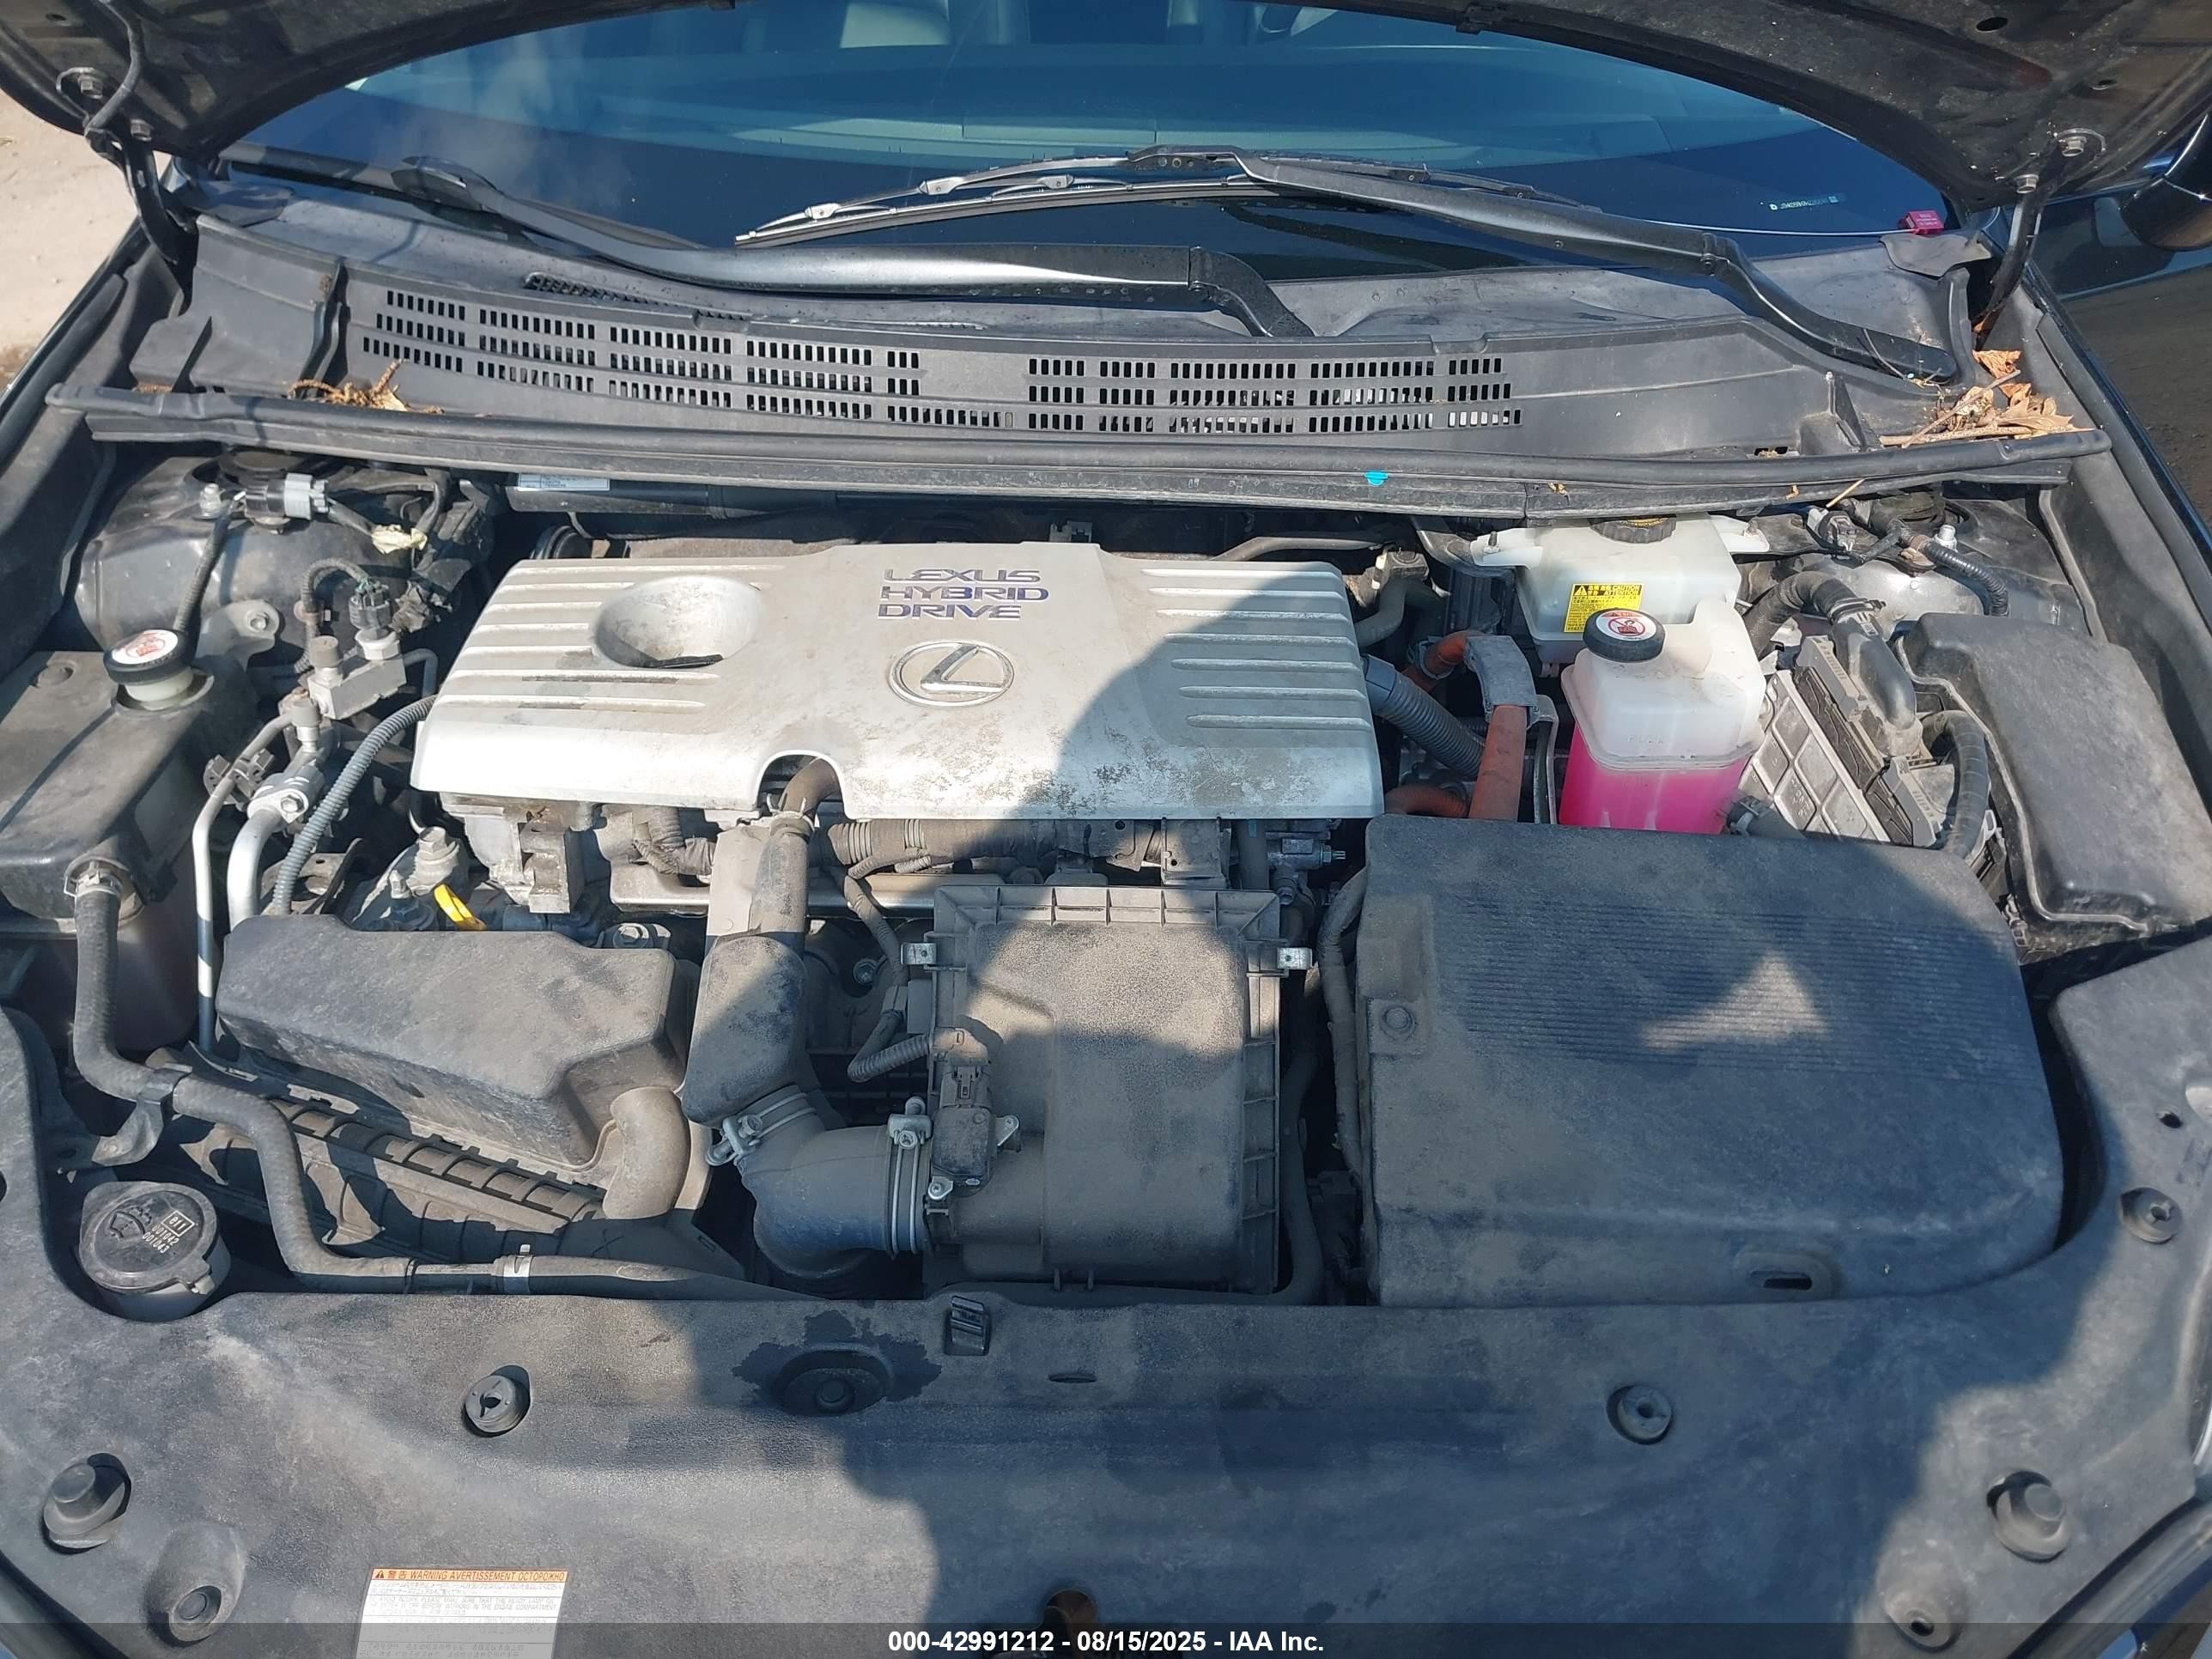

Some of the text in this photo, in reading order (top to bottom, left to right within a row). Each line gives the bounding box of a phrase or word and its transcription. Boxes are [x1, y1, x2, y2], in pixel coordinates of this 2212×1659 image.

[884, 568, 1041, 583] LEXUS
[880, 586, 1049, 601] HYBRID
[878, 604, 1022, 620] DRIVE
[142, 1231, 170, 1253] 001043
[410, 1571, 447, 1579] WARNING
[450, 1571, 515, 1580] AVERTISSEMENT
